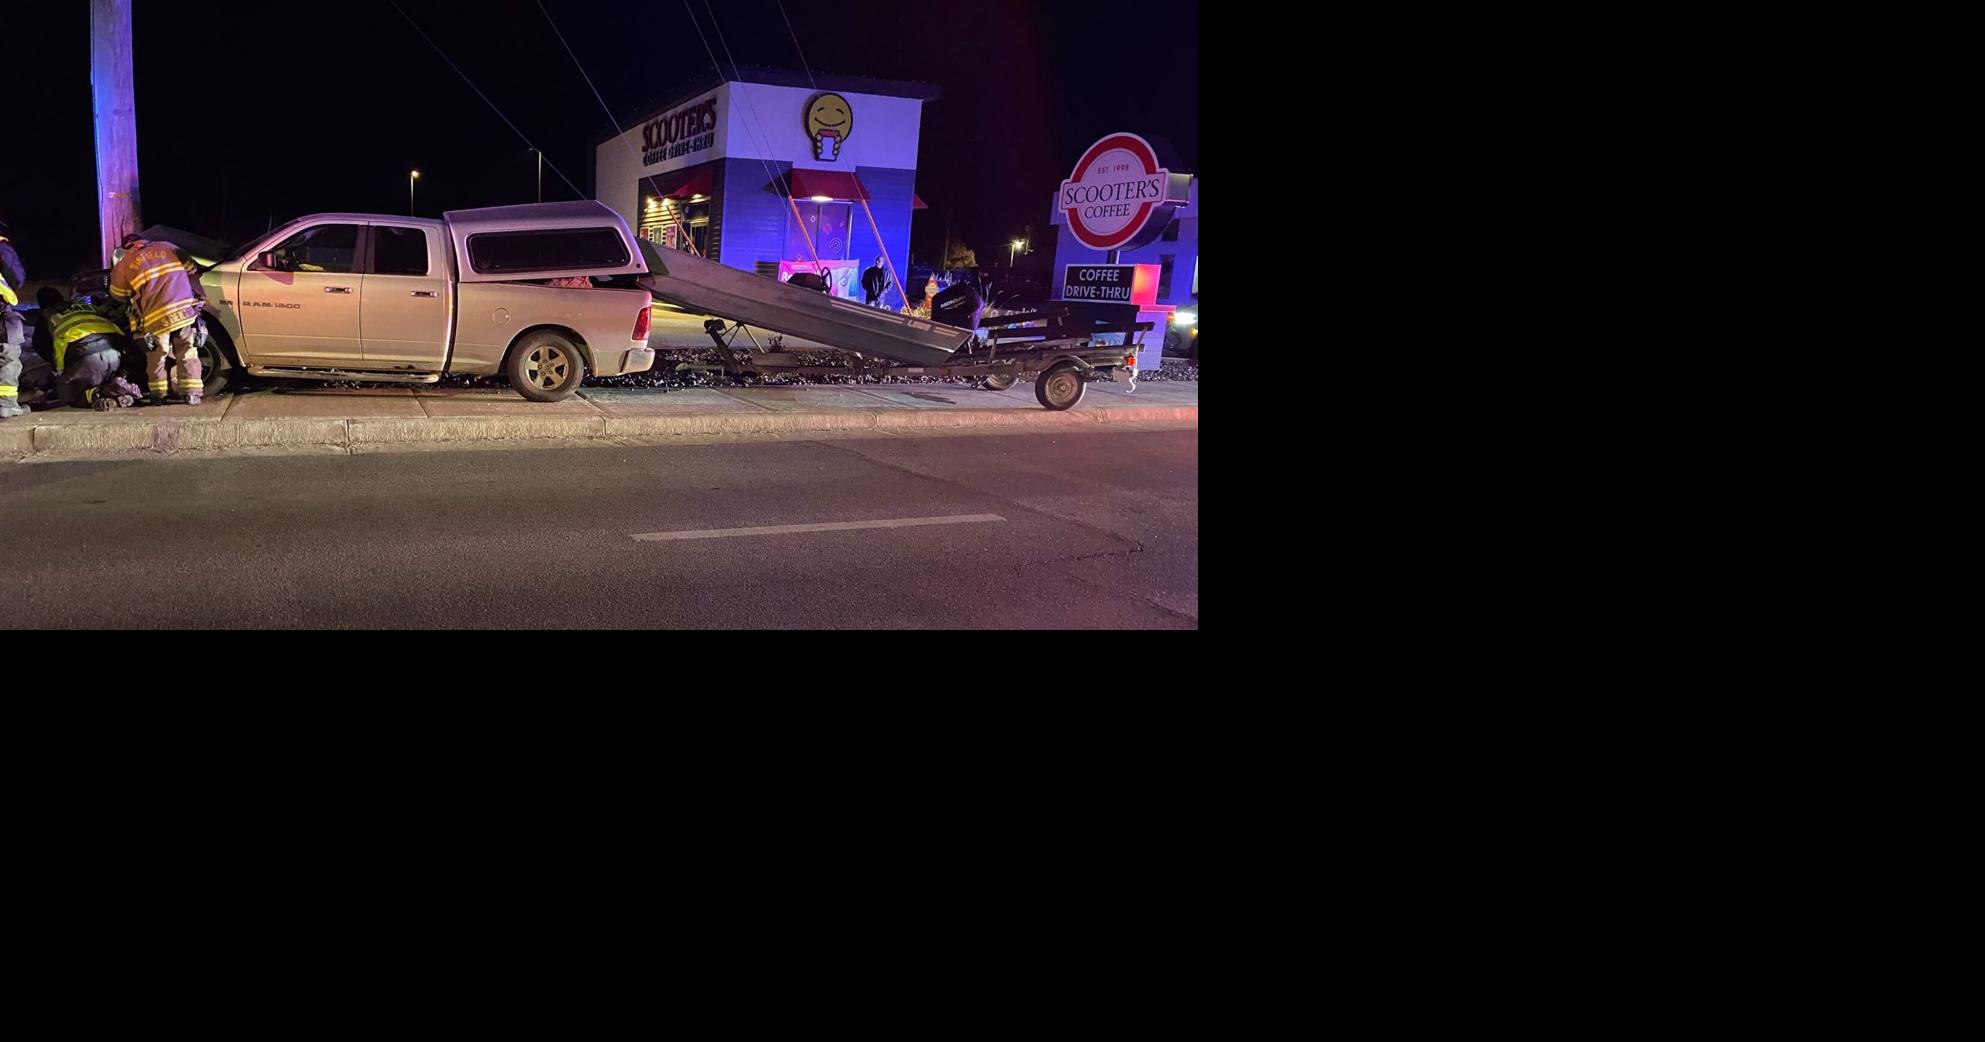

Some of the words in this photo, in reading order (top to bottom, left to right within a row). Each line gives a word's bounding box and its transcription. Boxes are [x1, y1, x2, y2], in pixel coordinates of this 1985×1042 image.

[642, 98, 717, 153] SCOOTER'S
[643, 146, 667, 167] COFFEE
[1065, 179, 1160, 204] SCOOTER'S
[1084, 203, 1130, 219] COFFEE
[1079, 269, 1120, 281] COFFEE
[1065, 285, 1130, 299] DRIVE-THRU
